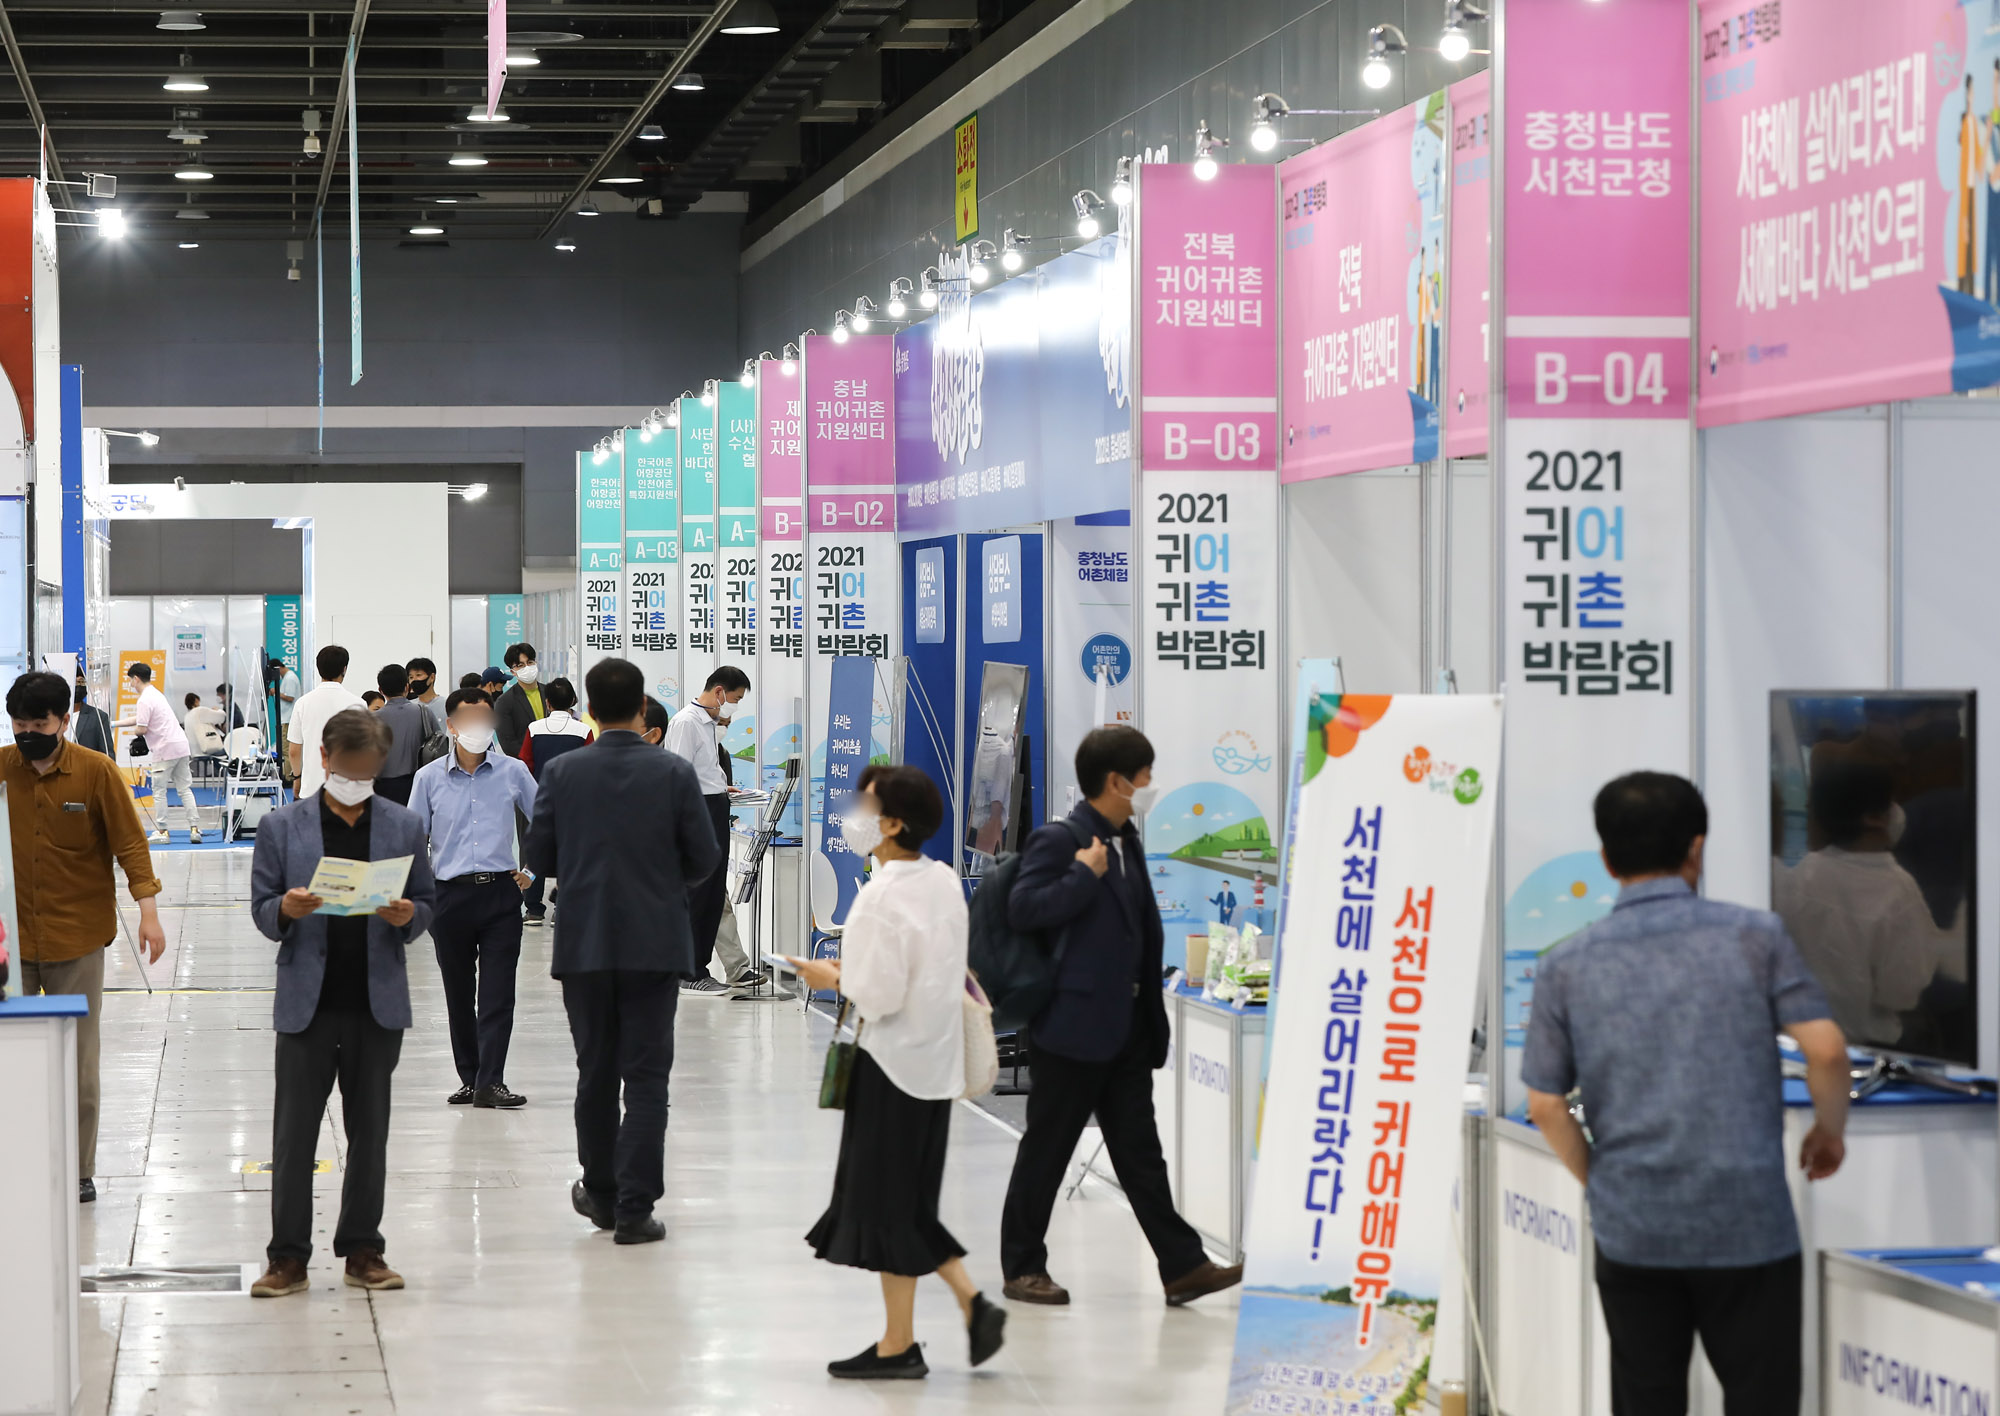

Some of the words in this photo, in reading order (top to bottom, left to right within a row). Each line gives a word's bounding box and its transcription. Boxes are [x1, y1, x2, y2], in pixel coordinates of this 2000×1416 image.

[1524, 111, 1672, 151] 충청남도
[1736, 97, 1800, 201] 서천에
[1805, 52, 1928, 184] 살어리랏다!
[1523, 158, 1672, 198] 서천군청
[1183, 232, 1235, 261] 전북
[1736, 207, 1819, 313] 서해바다
[1824, 180, 1926, 295] 서천으로!
[1155, 266, 1263, 294] 귀어귀촌
[1338, 242, 1362, 313] 전북
[1156, 299, 1262, 327] 지원센터
[1303, 330, 1349, 403] 귀어귀촌
[1351, 314, 1399, 391] 지원센터
[833, 379, 868, 398] 충남
[1535, 351, 1668, 405] B-04
[816, 400, 885, 419] 귀어귀촌
[730, 419, 755, 433] (사)
[770, 420, 800, 437] 귀어
[816, 422, 885, 440] 지원센터
[728, 436, 755, 451] 수산
[770, 440, 800, 456] 지원
[1163, 422, 1260, 461] B-03
[636, 468, 672, 478] 어항공단
[638, 457, 673, 467] 한국어촌
[1526, 450, 1622, 491] 2021
[638, 479, 673, 489] 인천어촌
[822, 501, 884, 526] B-02
[1157, 493, 1228, 523] 2021
[1523, 506, 1624, 561] 귀어
[590, 552, 621, 568] A-0
[635, 541, 677, 559] A-03
[817, 546, 865, 567] 2021
[1078, 551, 1128, 566] 충청남도
[1156, 533, 1229, 573] 귀어
[632, 572, 665, 587] 2021
[690, 563, 713, 579] 20
[1078, 568, 1128, 582] 어촌체험
[587, 580, 616, 592] 2021
[690, 583, 713, 604] 귀
[816, 572, 865, 598] 귀어
[586, 596, 616, 612] 귀어
[632, 590, 665, 608] 귀어
[1156, 580, 1230, 622] 귀촌
[1523, 571, 1624, 628] 귀촌
[586, 614, 616, 631] 귀촌
[632, 611, 665, 630] 귀촌
[690, 608, 713, 628] 귀
[816, 602, 866, 629] 귀촌
[281, 603, 299, 672] 금융정책
[817, 633, 889, 659] 박람회
[1156, 629, 1265, 670] 박람회
[1524, 640, 1672, 695] 박람회
[833, 714, 851, 730] 우리는
[832, 739, 861, 755] 귀어귀촌을
[831, 763, 849, 779] 하나의
[1336, 806, 1383, 951] 서천에
[1379, 885, 1434, 1082] 서천으로
[1305, 969, 1369, 1260] 살어리랏다!
[1353, 1101, 1411, 1346] 귀어해유!
[1504, 1188, 1577, 1256] INFORMATION
[1840, 1341, 1990, 1416] INFORMATION
